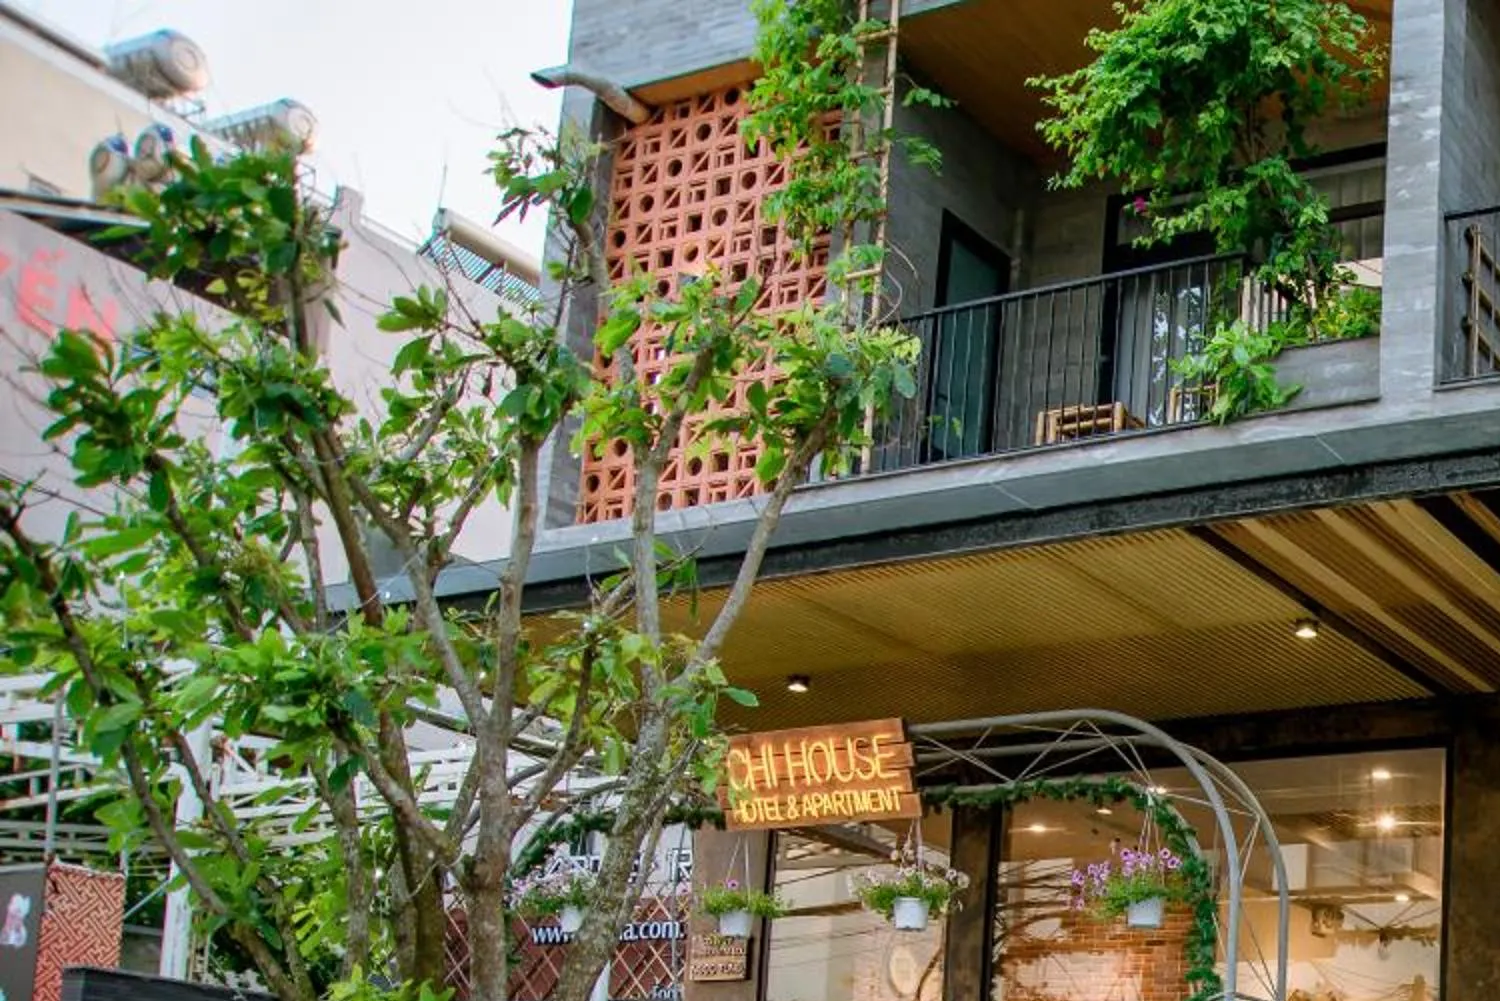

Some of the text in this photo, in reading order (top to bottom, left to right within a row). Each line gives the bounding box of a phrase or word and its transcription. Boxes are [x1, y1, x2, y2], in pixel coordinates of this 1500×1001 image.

[784, 734, 900, 787] HOUSE
[734, 786, 905, 824] HOTEL & APARTMENT
